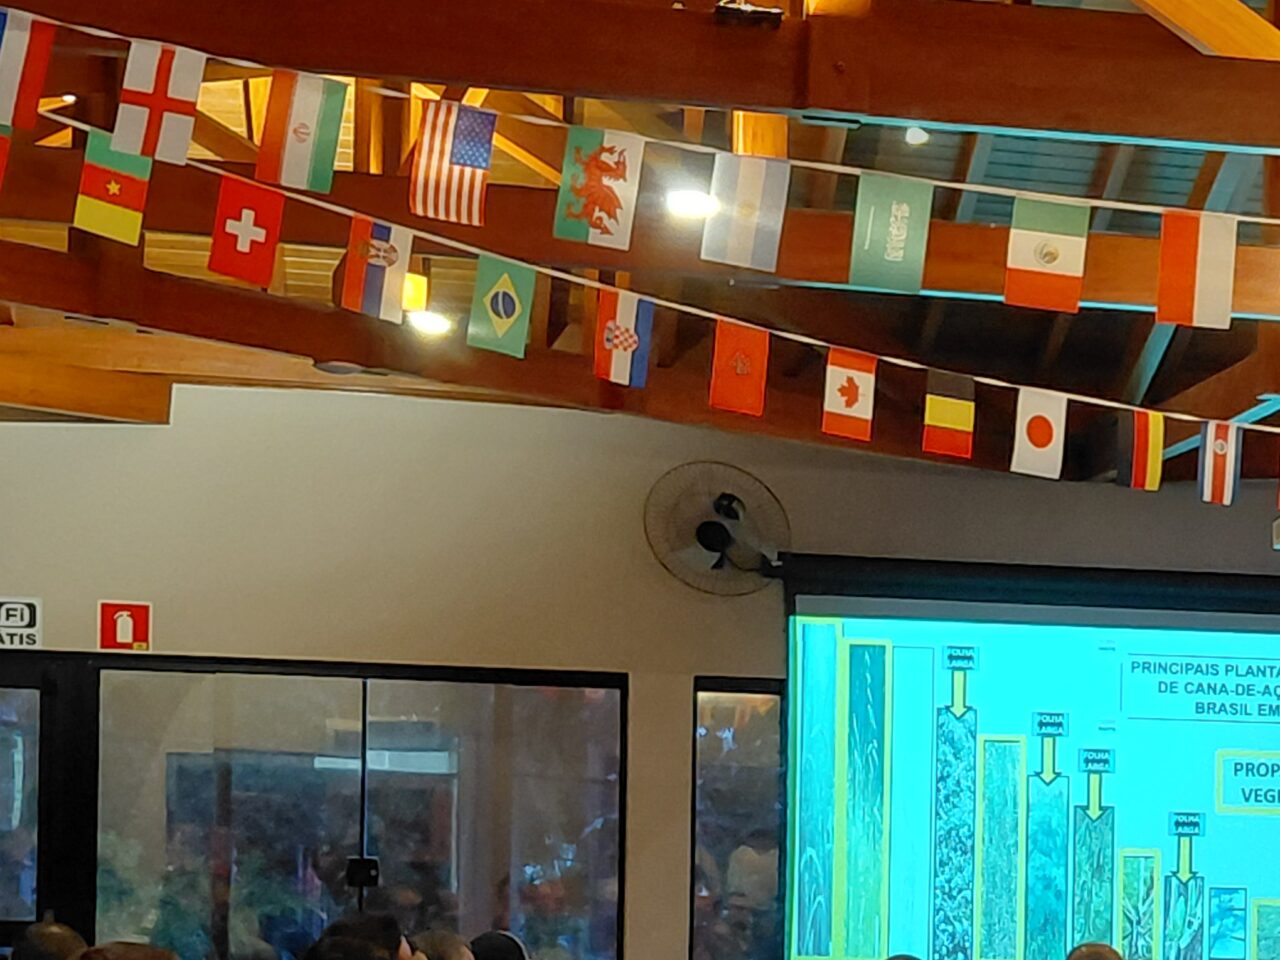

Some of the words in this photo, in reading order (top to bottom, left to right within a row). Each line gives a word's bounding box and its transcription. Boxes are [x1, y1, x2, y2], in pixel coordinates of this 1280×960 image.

[1130, 661, 1220, 677] PRINCIPAIS
[1158, 681, 1179, 694] DE
[1195, 702, 1253, 717] BRASIL
[1257, 703, 1280, 718] EM
